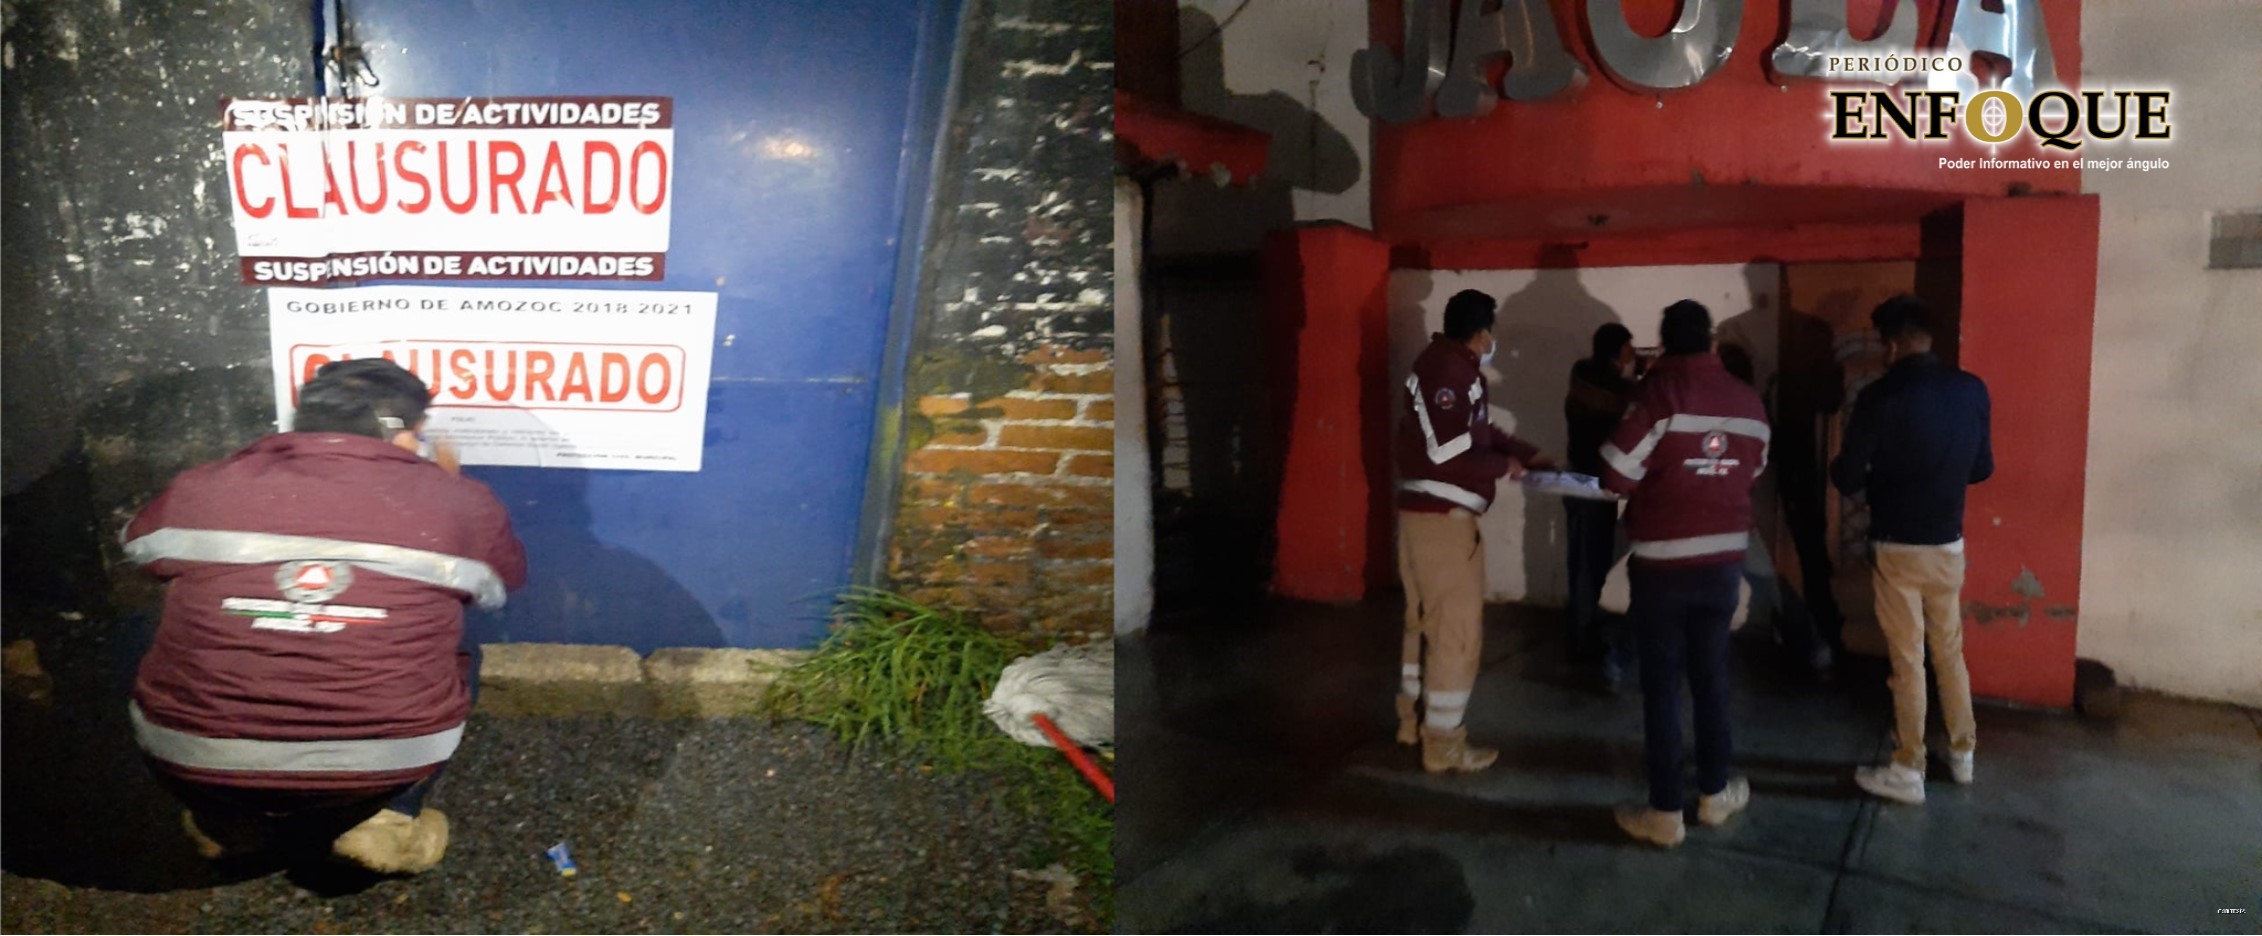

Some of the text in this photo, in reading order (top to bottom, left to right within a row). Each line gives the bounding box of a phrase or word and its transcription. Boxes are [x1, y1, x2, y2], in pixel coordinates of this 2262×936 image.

[415, 103, 455, 125] DE
[462, 102, 661, 126] ACTIVIDADES
[253, 252, 654, 282] SUSPNSIÓN DE ACTIVIDADES
[286, 298, 410, 315] GOBIERNO
[420, 299, 449, 311] DE
[460, 300, 562, 313] AMOZOC
[303, 349, 672, 404] CUSURADO
